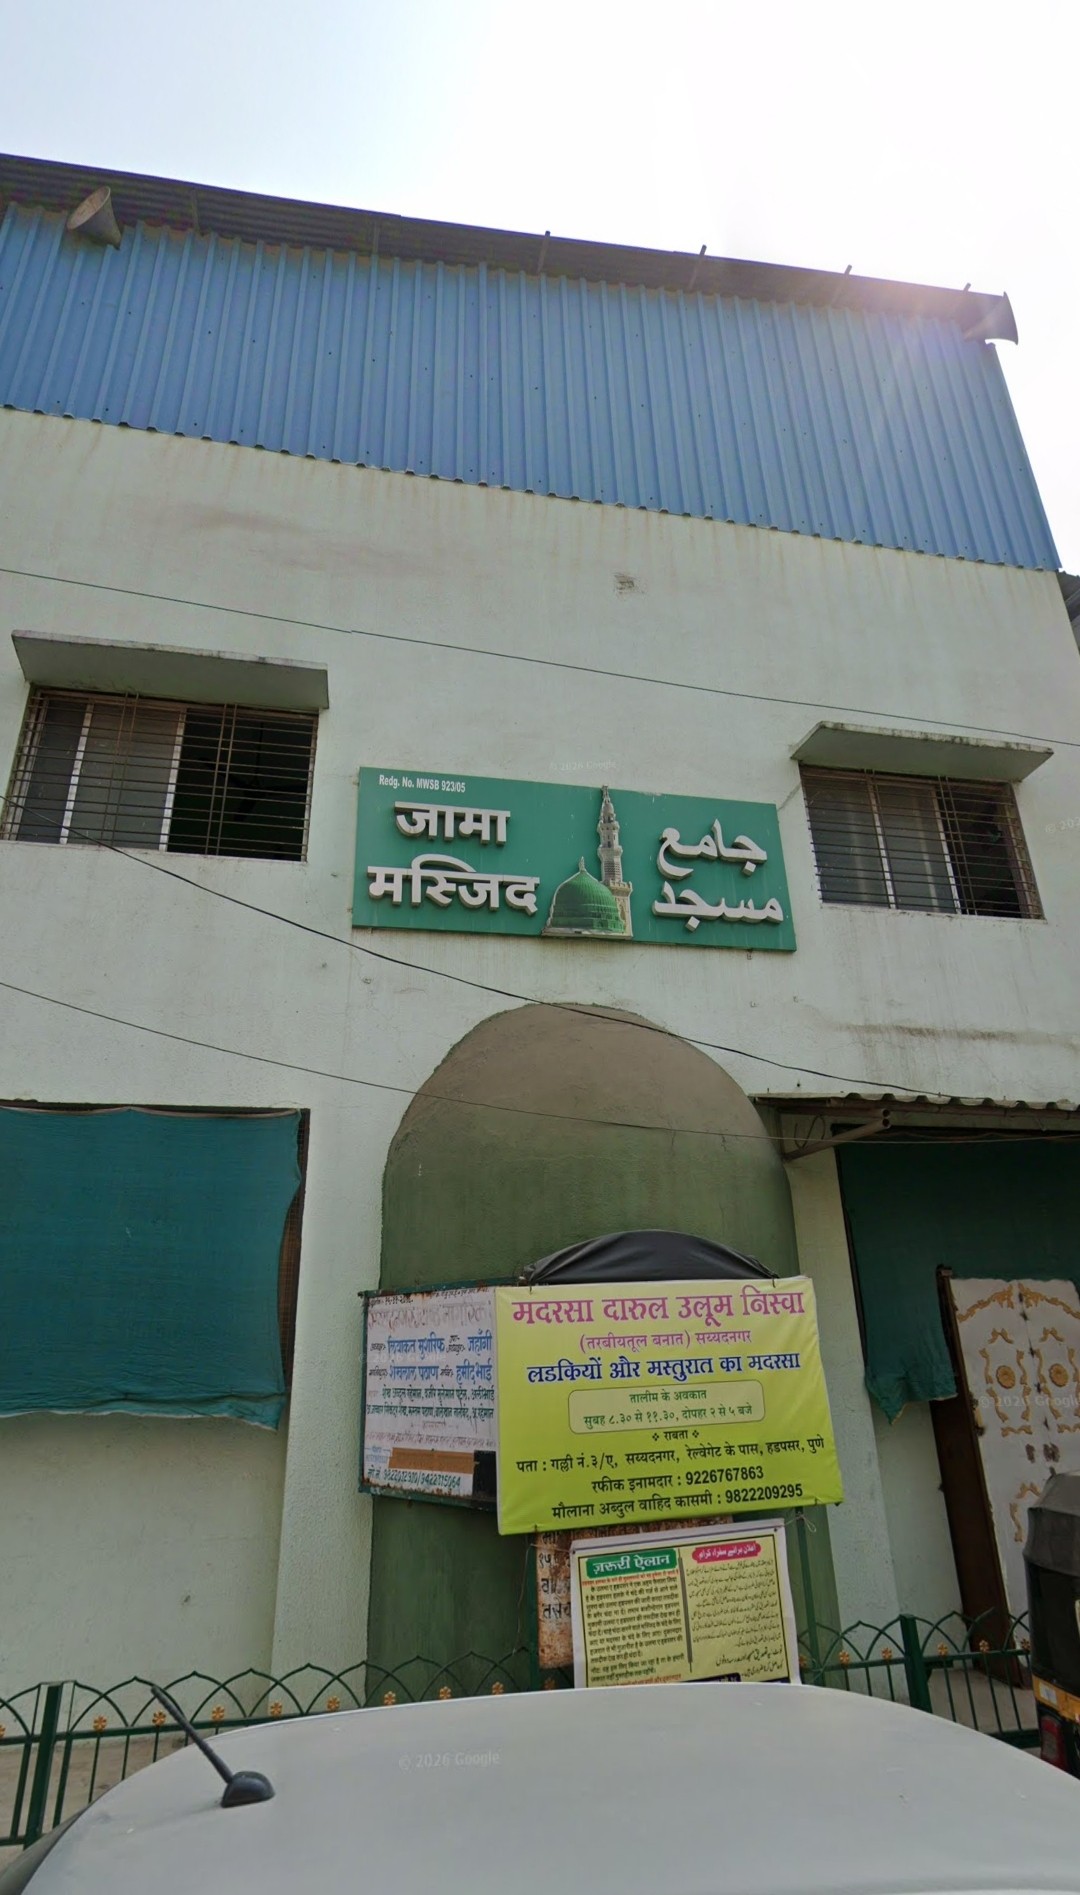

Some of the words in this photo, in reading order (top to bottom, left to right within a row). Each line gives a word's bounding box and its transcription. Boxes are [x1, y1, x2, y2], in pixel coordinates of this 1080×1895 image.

[379, 775, 400, 789] Redg.
[402, 776, 415, 788] No.
[416, 778, 440, 790] MWSB
[441, 780, 466, 793] 923/05
[394, 801, 511, 846] जामा
[657, 818, 767, 880] جامع
[367, 853, 540, 916] मस्जिद
[652, 880, 784, 932] مسجد
[512, 1300, 595, 1324] मदरसा
[601, 1297, 670, 1321] दारुल
[676, 1295, 734, 1327] उलूम
[740, 1284, 805, 1316] निस्वा
[695, 1330, 752, 1345] सय्यदनगर
[527, 1357, 602, 1383] लडकियों
[610, 1356, 640, 1379] और
[646, 1358, 714, 1382] मस्तुरात
[719, 1356, 743, 1375] का
[747, 1353, 801, 1371] मदरसा
[629, 1389, 659, 1403] तालीम
[661, 1388, 671, 1401] के
[674, 1389, 707, 1401] अवकात
[583, 1415, 606, 1430] सुबह
[608, 1412, 632, 1425] ८.३०
[634, 1409, 643, 1423] से
[681, 1406, 706, 1420] दोपहर
[710, 1408, 716, 1417] २
[718, 1404, 727, 1416] से
[728, 1406, 736, 1417] ५
[737, 1402, 753, 1415] बजे
[663, 1430, 689, 1442] राबता
[516, 1460, 538, 1473] पता
[550, 1454, 574, 1472] गल्ली
[685, 1443, 722, 1460] रेल्वेगेट
[723, 1441, 736, 1456] के
[738, 1443, 764, 1456] पास,
[807, 1434, 825, 1453] पुणे
[591, 1476, 625, 1493] रफीक
[628, 1474, 673, 1492] इनामदार
[685, 1465, 764, 1486] 9226767863
[552, 1501, 595, 1519] मौलाना
[600, 1500, 635, 1518] अब्दुल
[638, 1493, 671, 1511] वाहिद
[674, 1490, 712, 1508] कासमी
[725, 1483, 803, 1503] 9822209295
